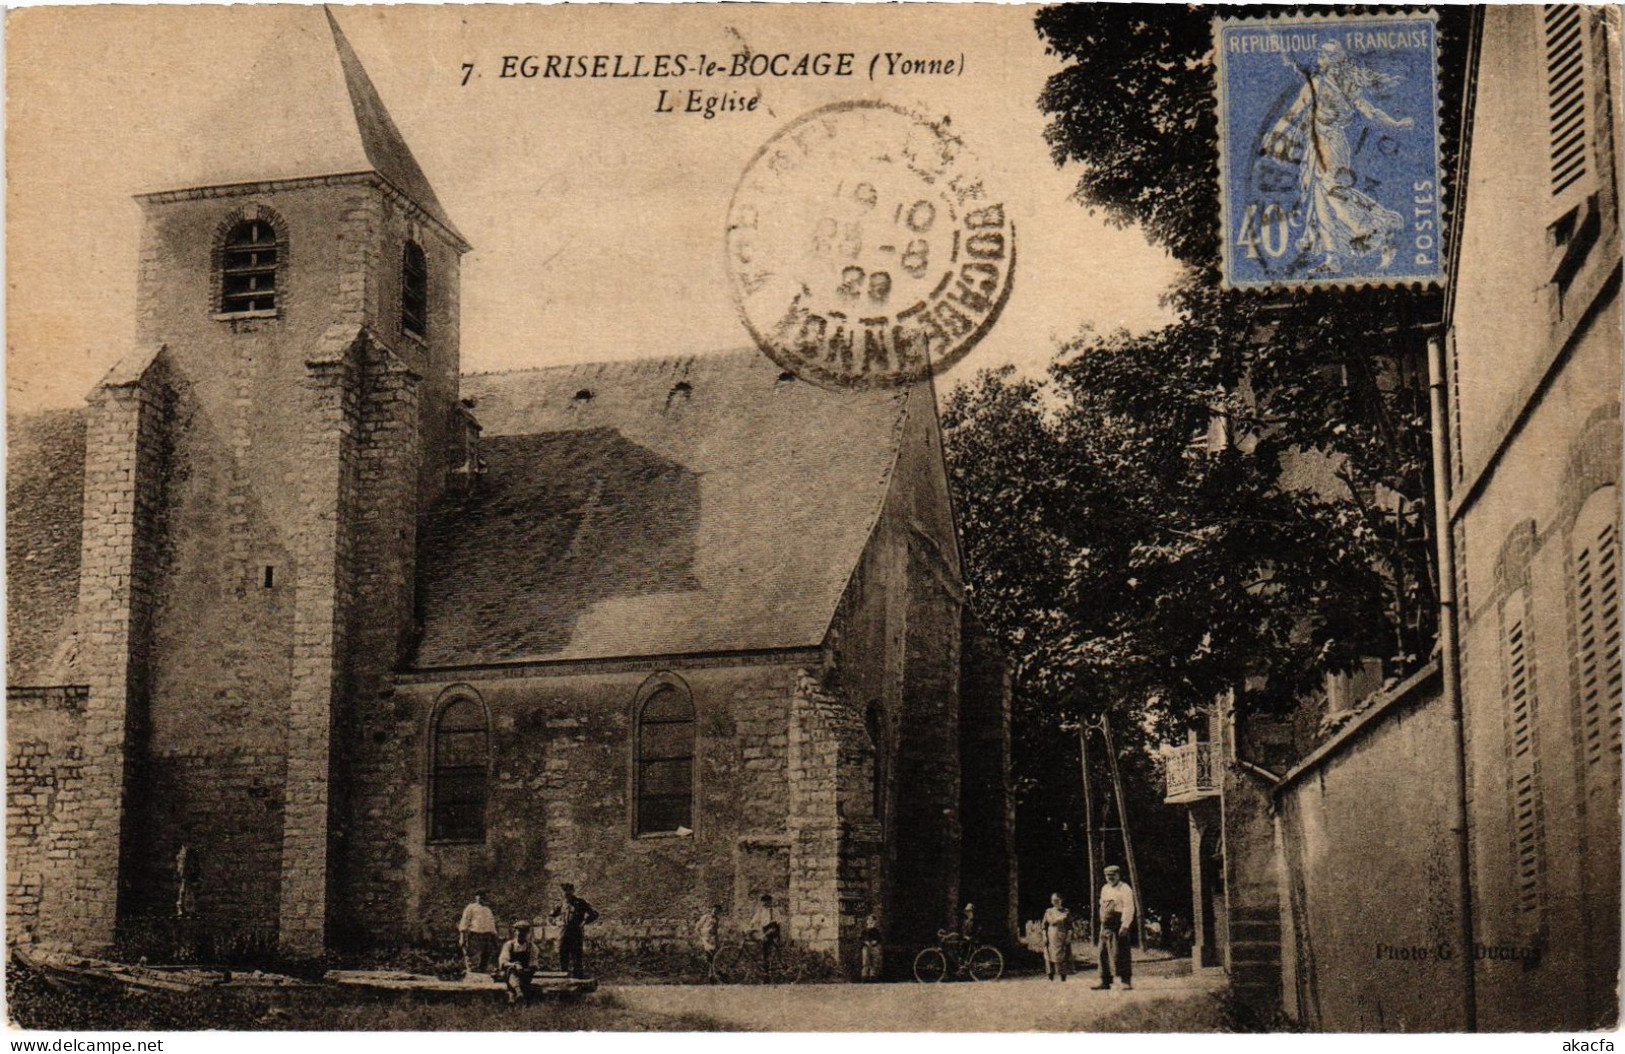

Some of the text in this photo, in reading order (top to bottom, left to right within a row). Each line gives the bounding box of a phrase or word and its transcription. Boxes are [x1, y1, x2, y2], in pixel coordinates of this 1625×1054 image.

[500, 54, 855, 78] EGRISELLES-le-BOCAGE
[869, 54, 964, 78] (Yonne)
[1415, 180, 1434, 265] POSTES
[1376, 943, 1428, 961] Photo
